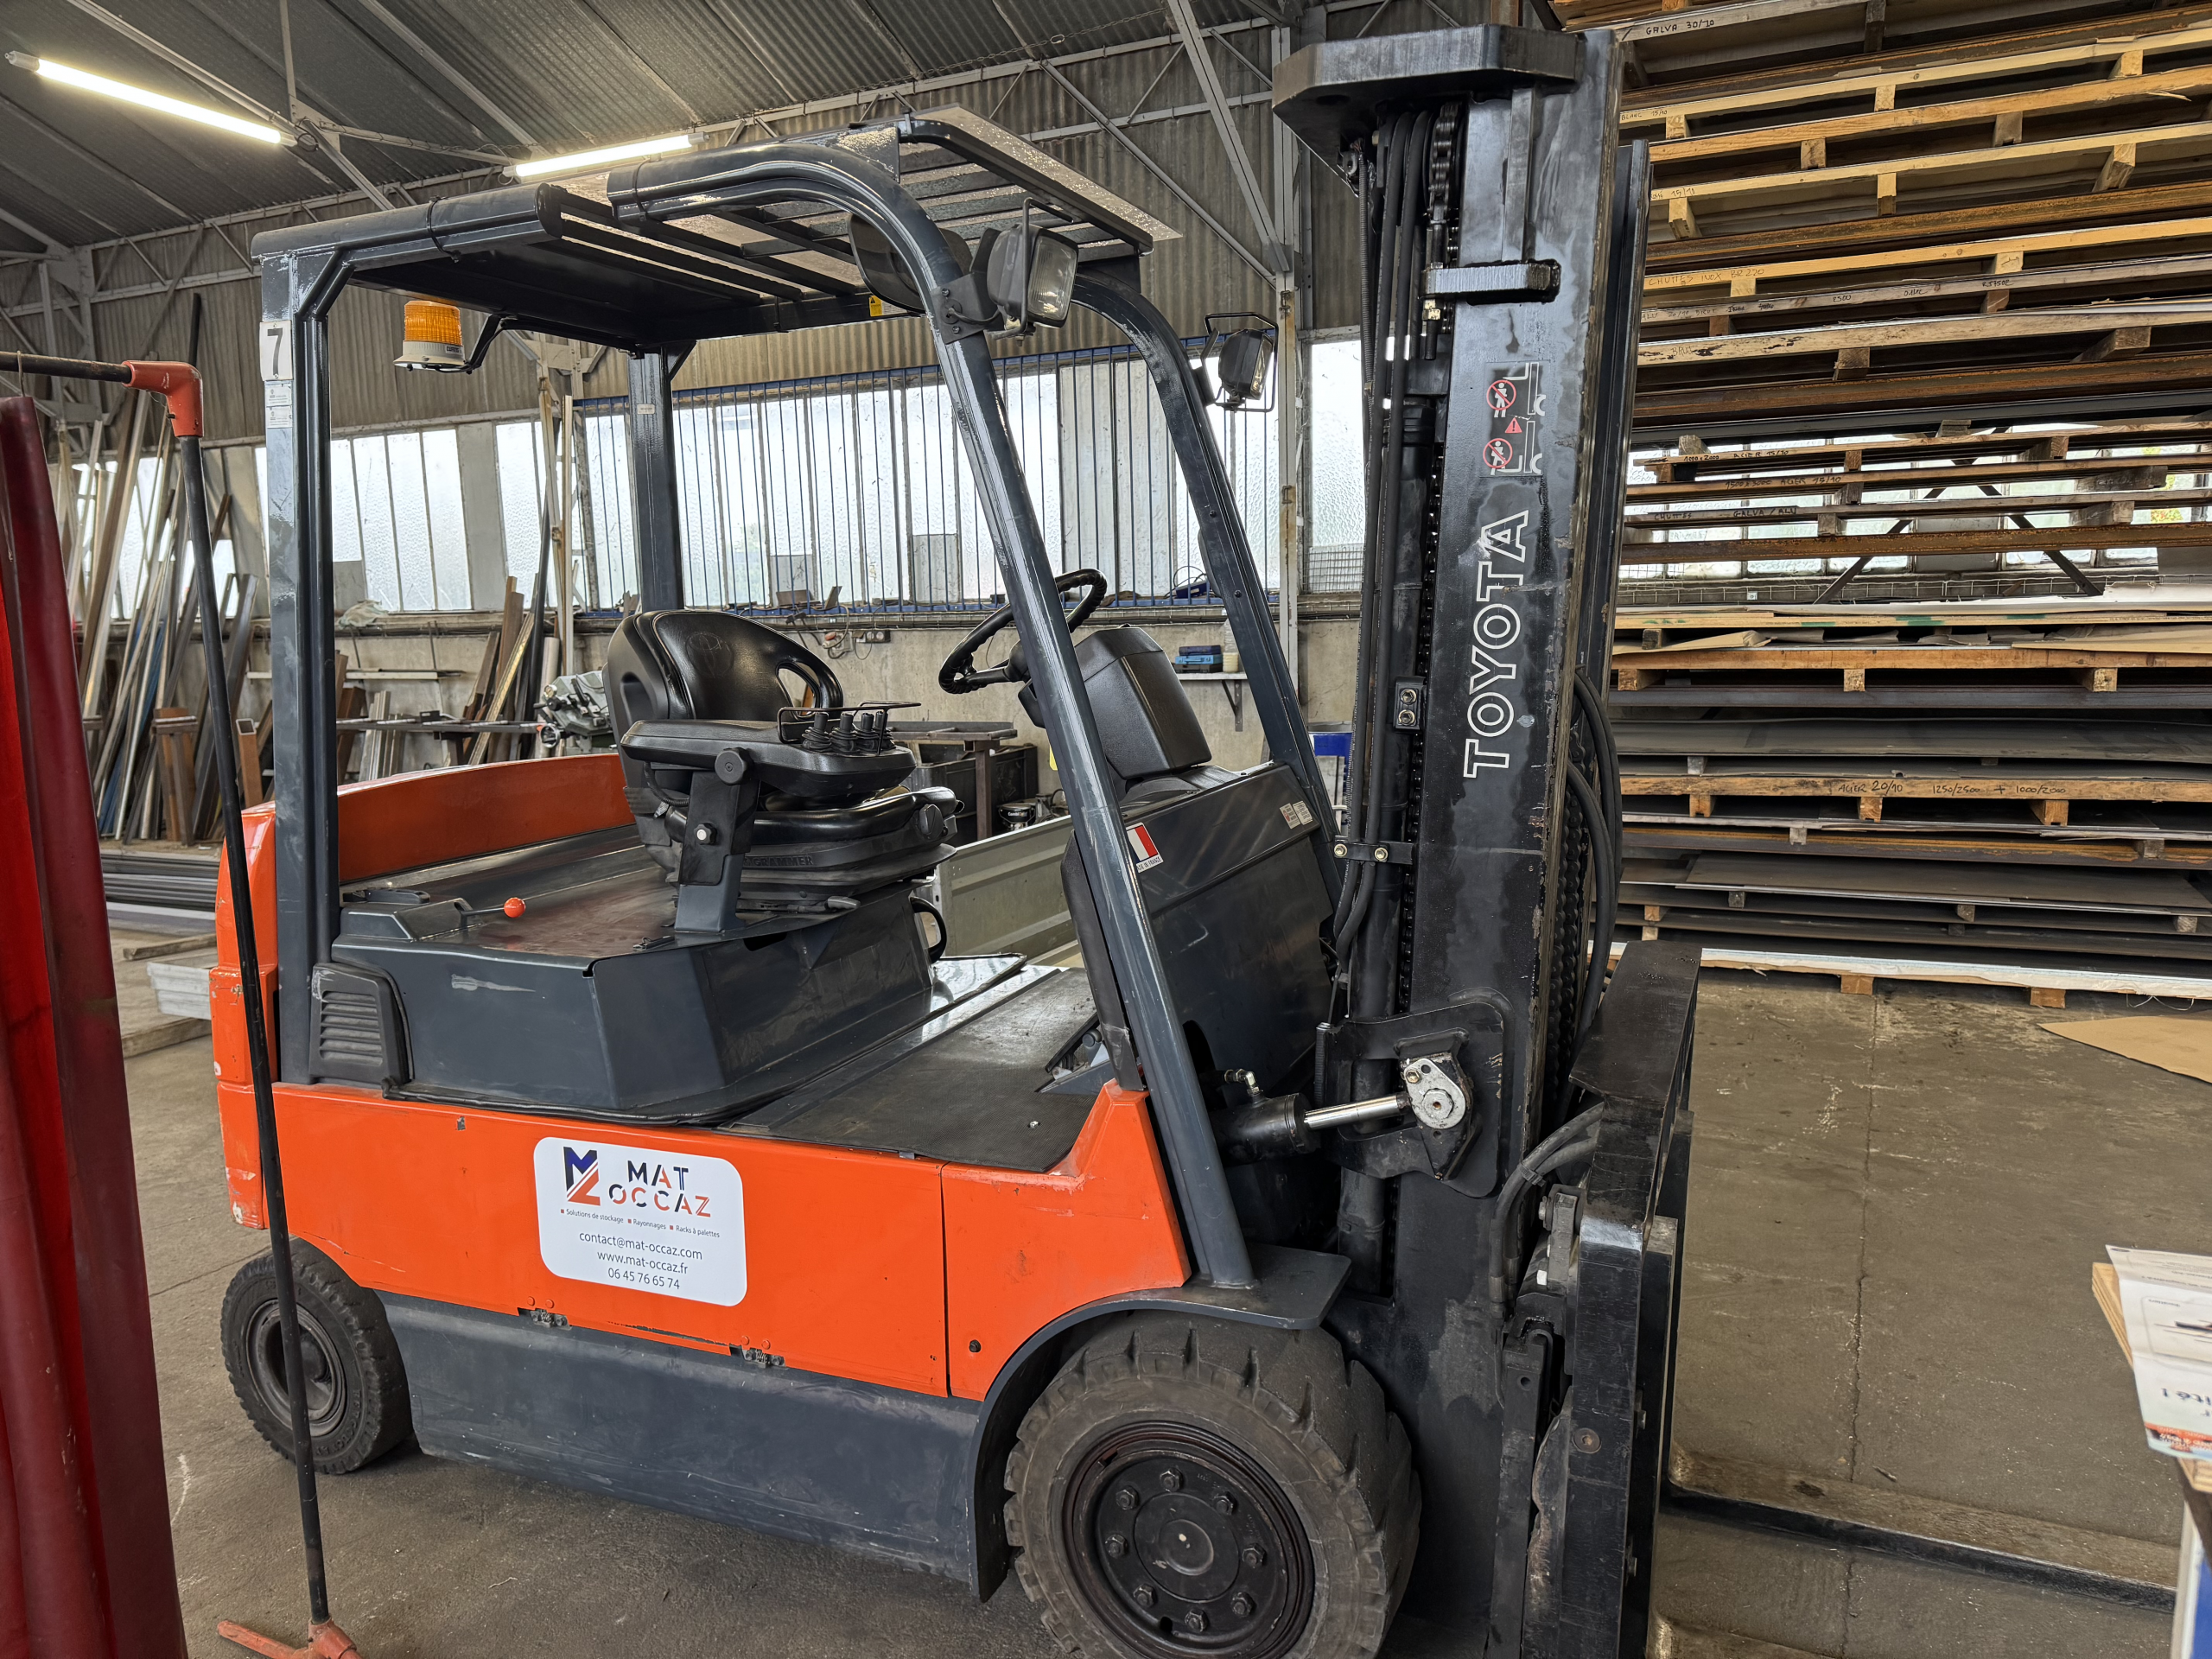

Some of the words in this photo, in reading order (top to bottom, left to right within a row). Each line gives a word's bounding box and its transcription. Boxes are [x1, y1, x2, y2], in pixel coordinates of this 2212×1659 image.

[1646, 23, 1677, 35] GALVA
[1686, 19, 1715, 29] 30/10
[267, 327, 283, 376] 7
[1733, 509, 1764, 518] GALVA
[1463, 510, 1529, 779] TOYOTA
[1872, 779, 1904, 796] 20/10
[626, 1160, 690, 1191] MAT
[607, 1183, 711, 1218] OCCAZ
[566, 1208, 591, 1219] Solutions
[591, 1211, 599, 1220] de
[600, 1211, 624, 1224] stockage
[632, 1218, 666, 1230] Rayonnages
[676, 1224, 692, 1235] Racks
[697, 1228, 720, 1238] palettes
[579, 1230, 703, 1261] contact@mat-occaz.com
[597, 1250, 689, 1275] www.mat-occaz.fr
[607, 1267, 621, 1280] 06
[622, 1269, 635, 1282] 45
[638, 1271, 651, 1285] 76
[652, 1274, 665, 1287] 65
[667, 1275, 681, 1290] 74
